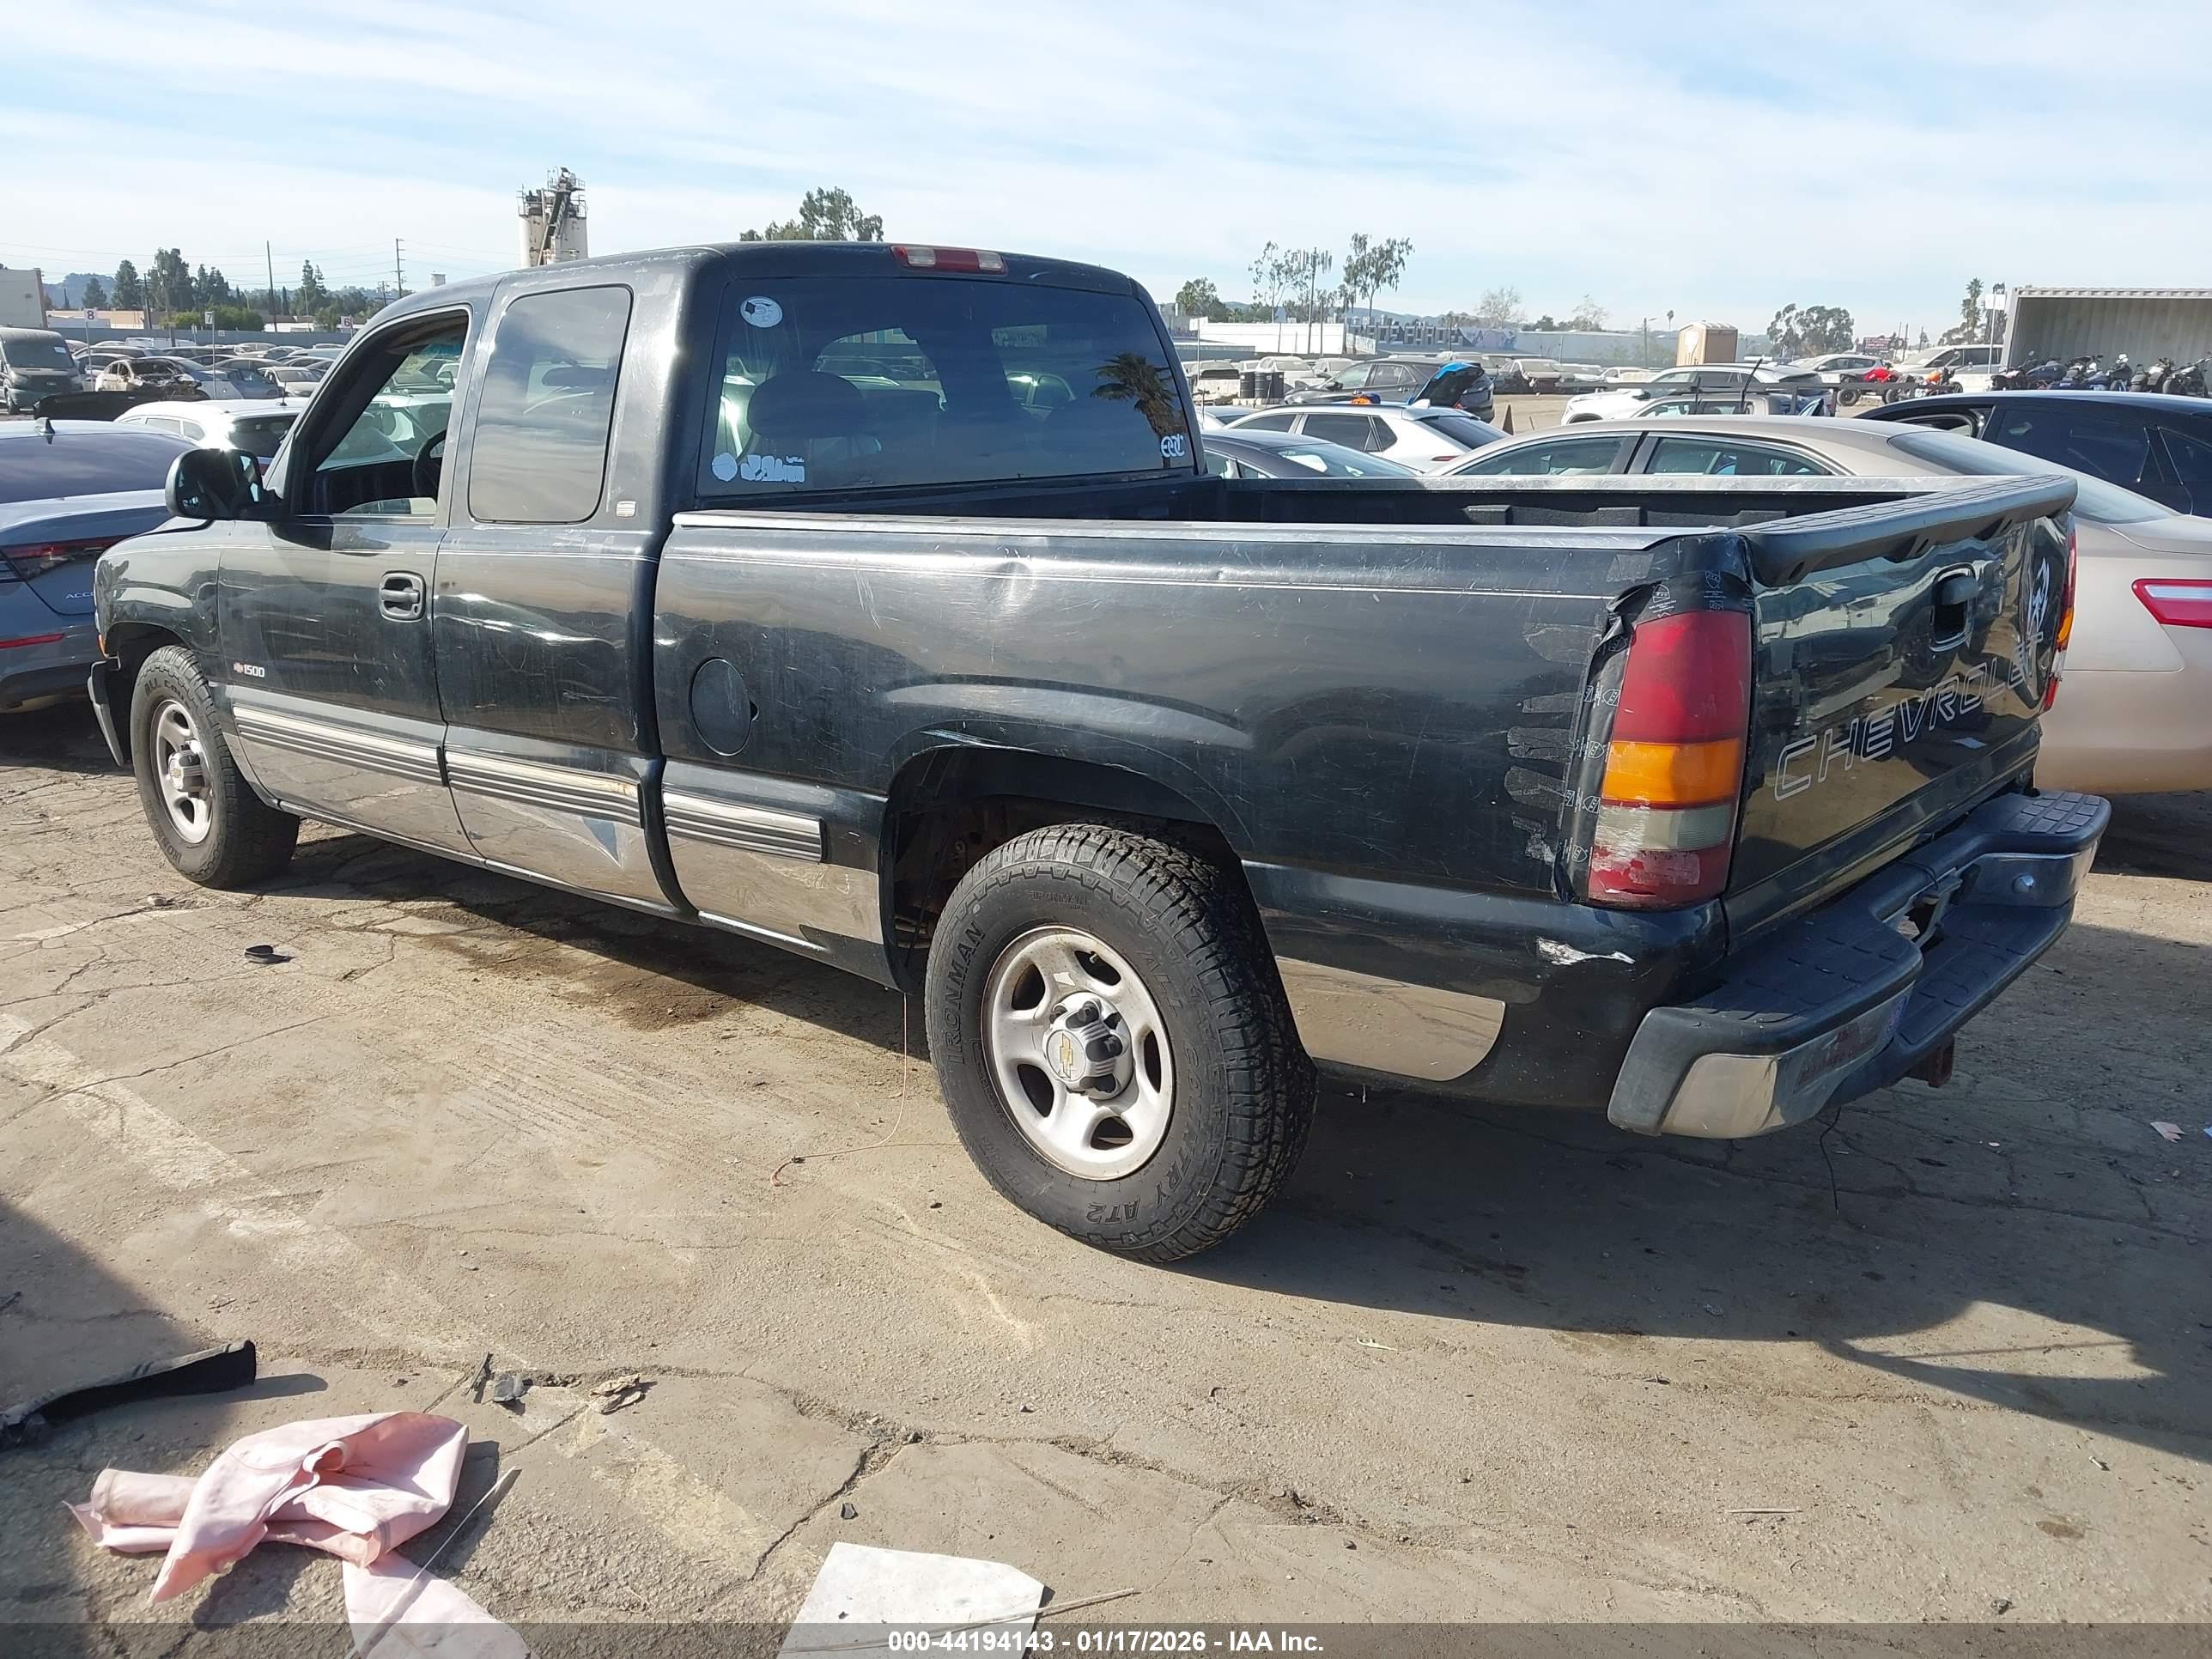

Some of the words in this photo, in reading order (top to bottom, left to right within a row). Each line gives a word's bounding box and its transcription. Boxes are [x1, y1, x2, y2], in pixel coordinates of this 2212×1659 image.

[87, 310, 95, 320] 8
[343, 318, 350, 327] 6
[244, 663, 265, 678] 1500
[1775, 632, 2044, 801] CHEVROLET
[944, 920, 986, 1065] IRONMAN
[1135, 950, 1184, 1018] ALL
[1085, 1196, 1140, 1224] AT2
